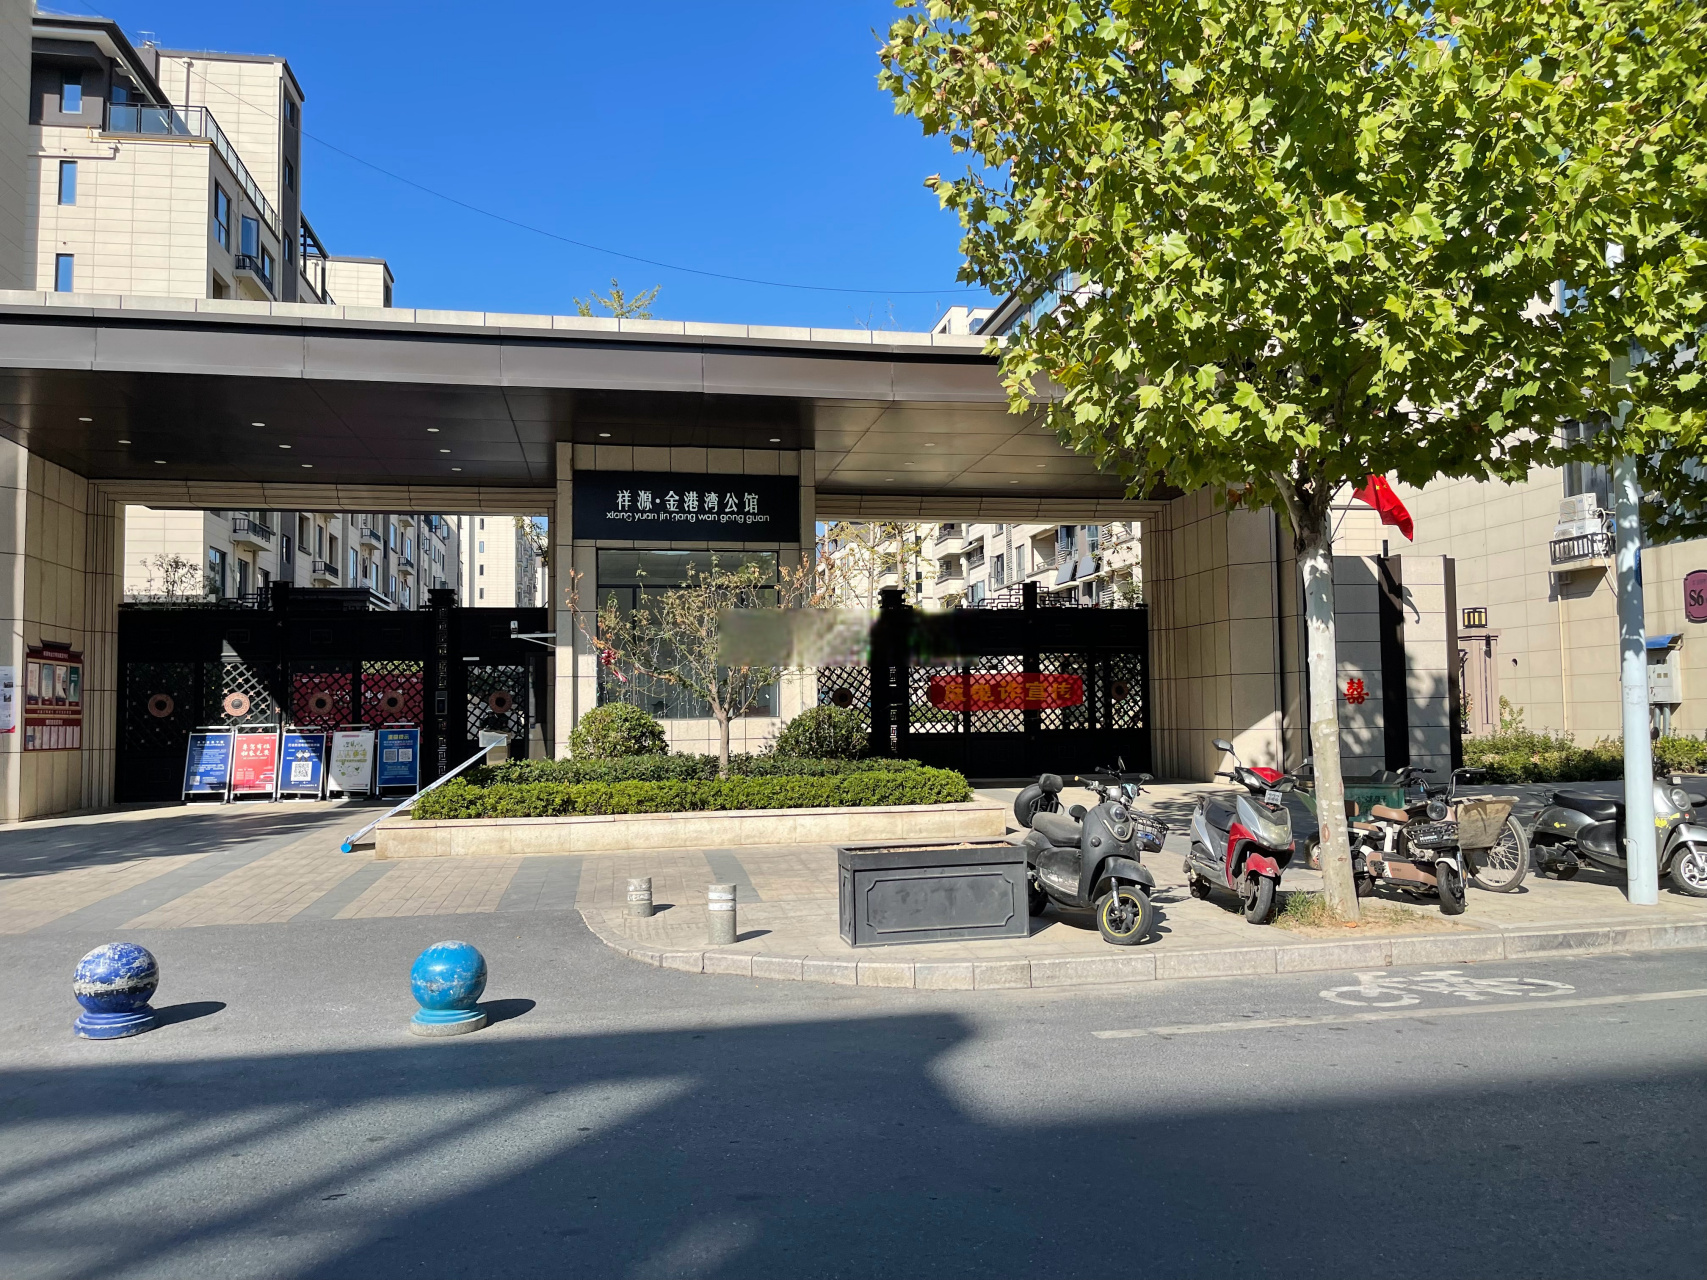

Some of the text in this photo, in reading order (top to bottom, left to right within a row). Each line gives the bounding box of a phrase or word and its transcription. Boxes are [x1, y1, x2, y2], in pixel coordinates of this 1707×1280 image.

[616, 489, 759, 514] 祥源·金港湾公馆
[634, 512, 657, 522] yuan
[659, 511, 670, 522] jin
[698, 513, 717, 521] wan
[720, 513, 744, 523] gong
[746, 514, 770, 523] guan
